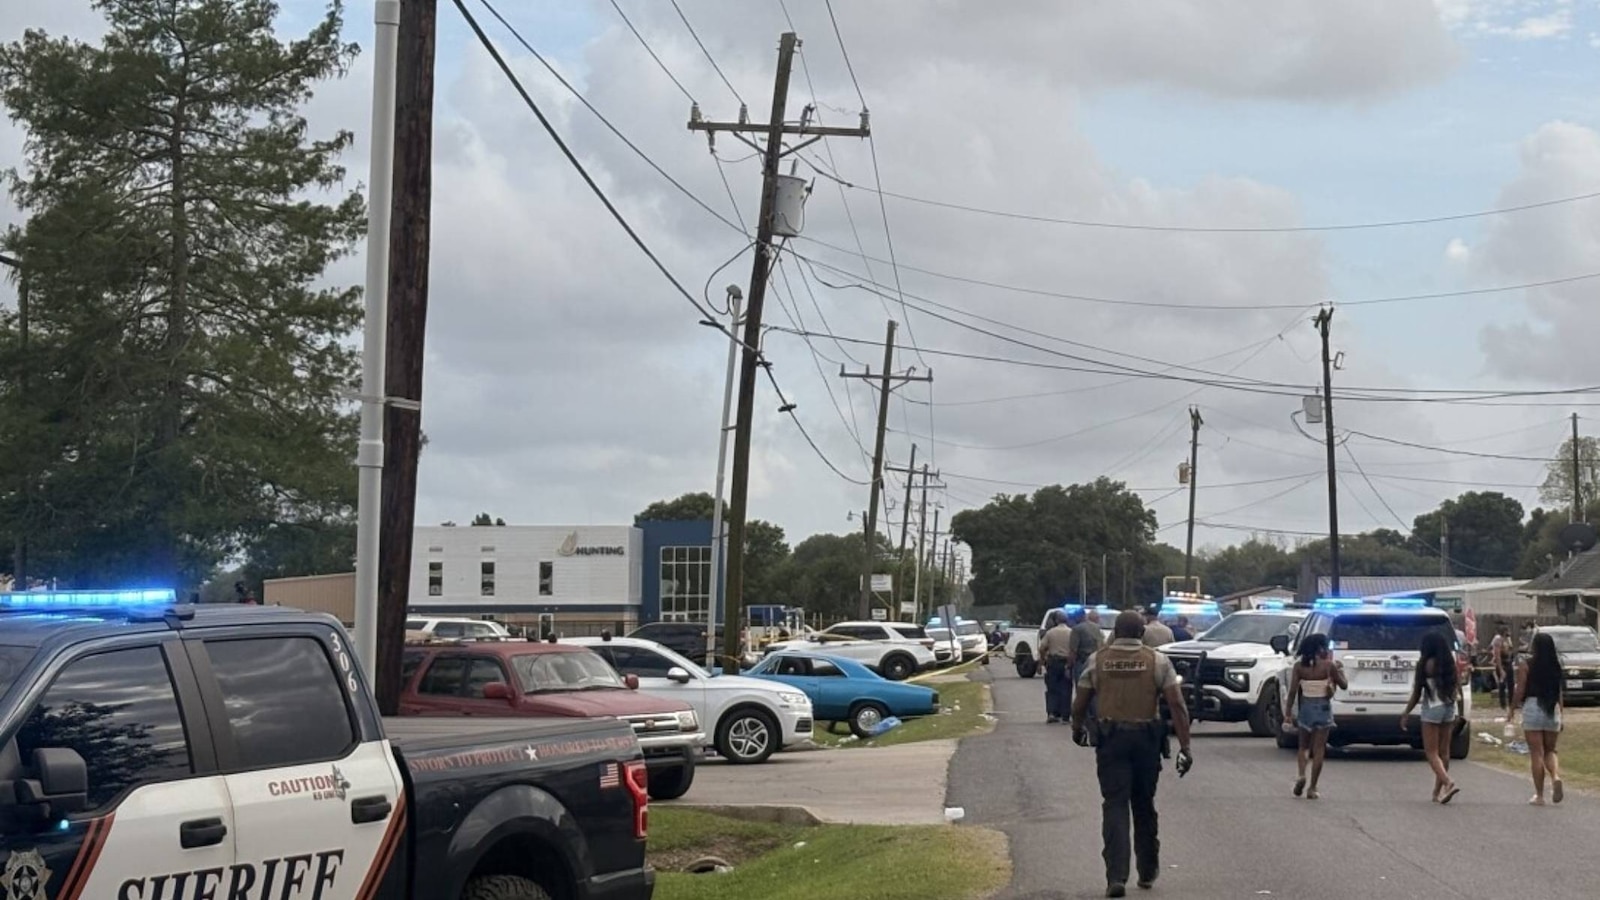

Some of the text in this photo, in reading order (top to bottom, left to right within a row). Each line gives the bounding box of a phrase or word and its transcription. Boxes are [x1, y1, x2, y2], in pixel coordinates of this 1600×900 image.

[576, 546, 625, 556] HUNTING
[330, 632, 357, 692] 306
[1103, 660, 1146, 670] SHERIFF
[1358, 660, 1418, 669] STATE POL
[410, 756, 454, 773] SWORN
[472, 747, 524, 767] PROTECT
[268, 775, 337, 796] CAUTION
